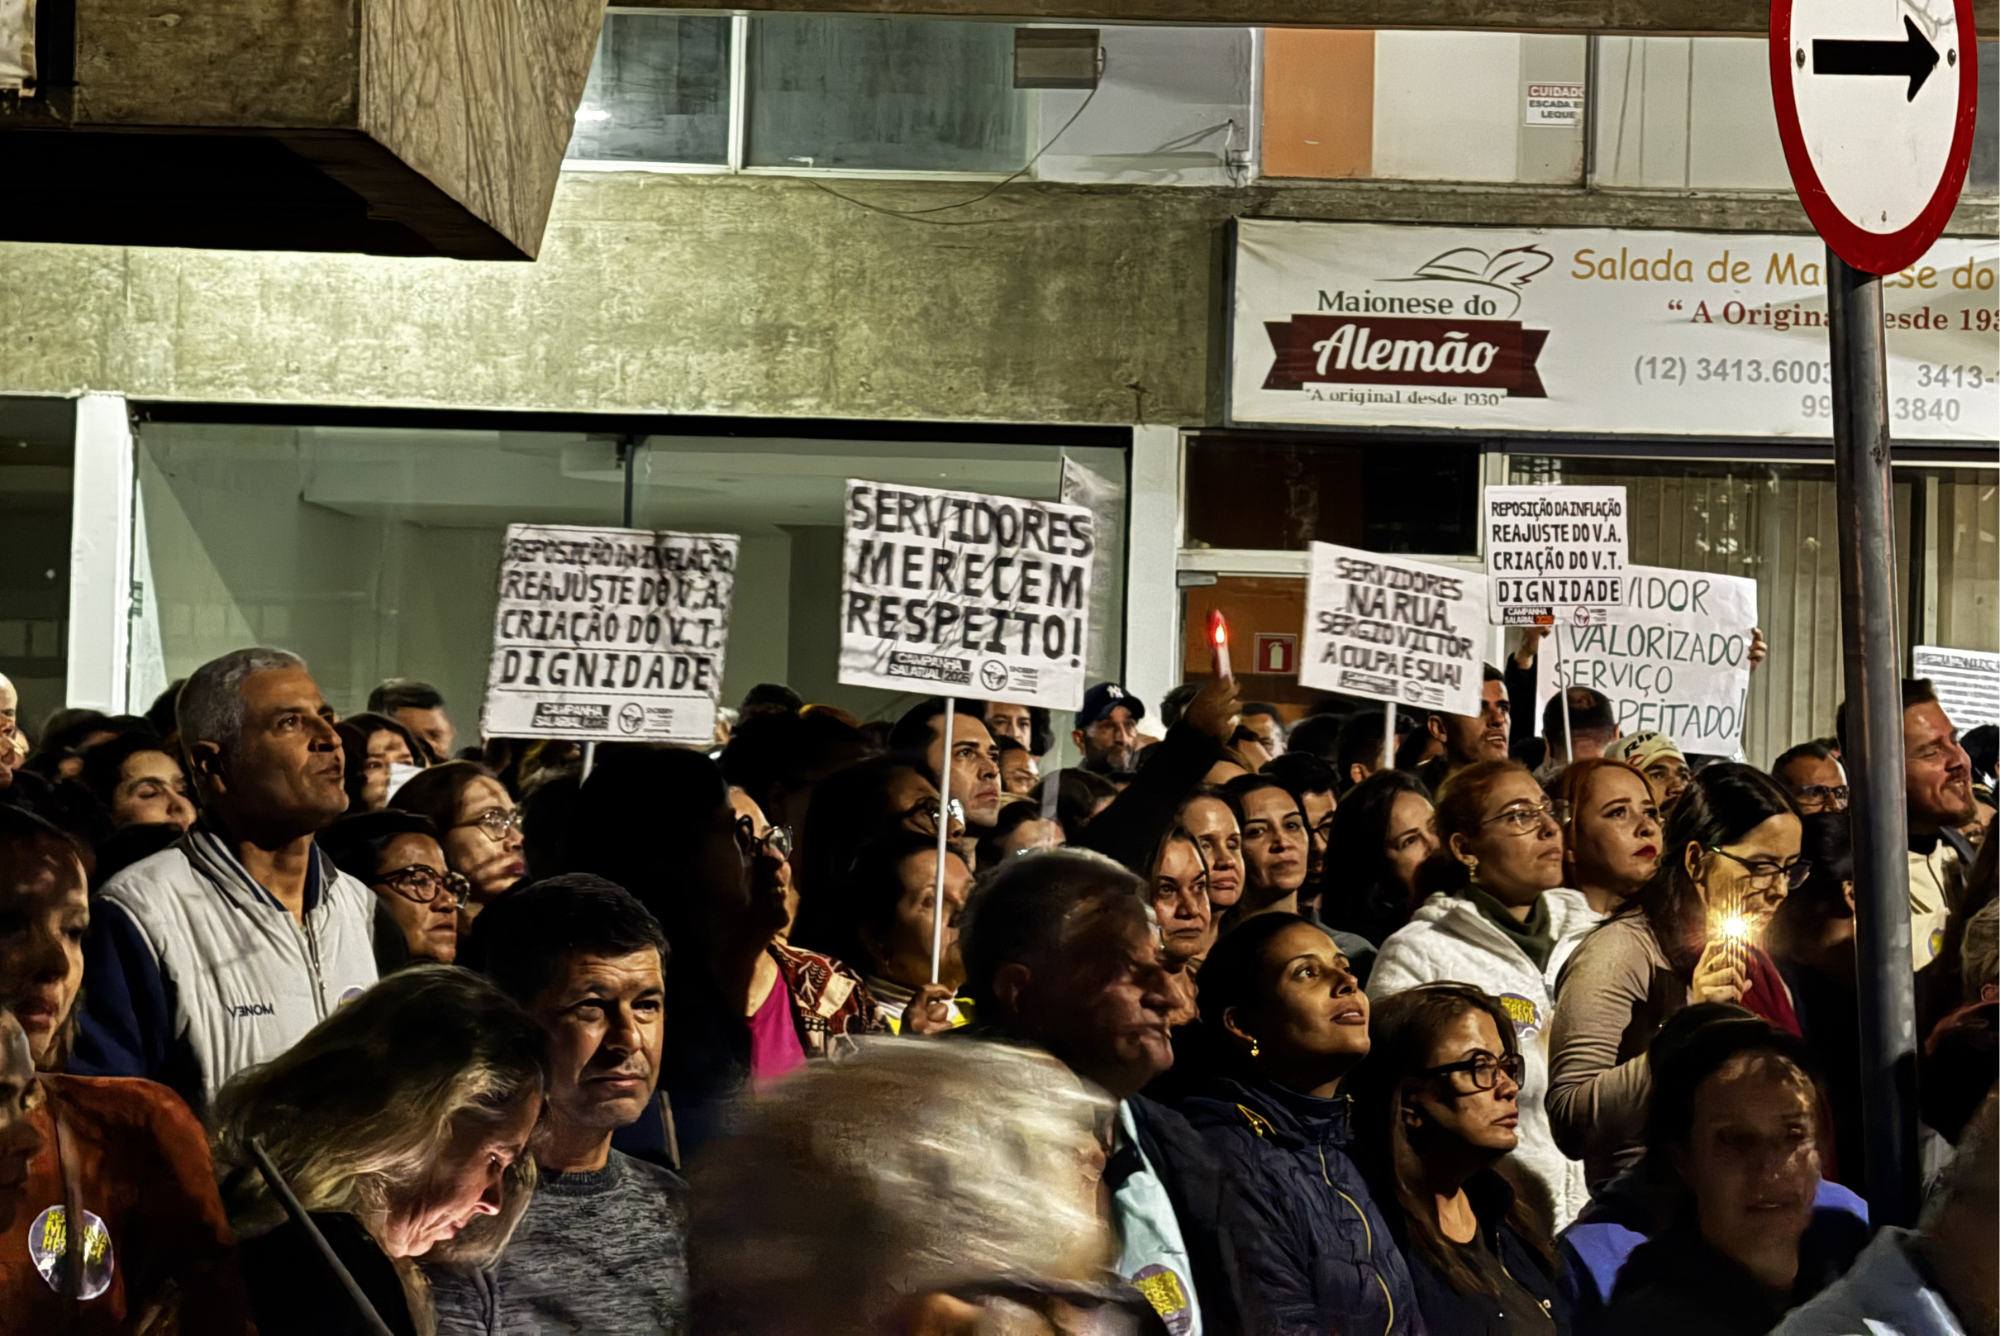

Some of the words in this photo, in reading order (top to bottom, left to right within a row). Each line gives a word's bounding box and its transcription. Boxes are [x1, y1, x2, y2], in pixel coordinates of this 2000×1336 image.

[1528, 100, 1571, 108] ESCADA
[1541, 110, 1576, 118] LEQUE
[1571, 247, 1694, 282] Salada
[1707, 250, 1752, 284] de
[1952, 256, 1995, 291] do
[1317, 289, 1454, 315] Maionese
[1464, 295, 1497, 316] do
[1723, 301, 1829, 331] Origin
[1885, 306, 1948, 331] esde
[1312, 323, 1500, 376] Alemão
[1634, 355, 1687, 386] (12)
[1917, 363, 2000, 389] 3413-
[1329, 389, 1401, 406] original
[1407, 391, 1457, 406] desde
[851, 486, 1094, 558] SERVIDORES
[1491, 497, 1553, 521] REPOSIÇÃO
[1492, 524, 1569, 542] REAJUSTE
[1572, 524, 1590, 542] DO
[1593, 524, 1622, 543] V.A.
[857, 539, 1085, 609] MERECEM
[1493, 546, 1564, 576] CRIAÇÃO
[1569, 551, 1588, 570] DO
[1592, 551, 1623, 571] V.T.
[502, 570, 635, 605] REAJUSTE
[638, 577, 670, 607] DO
[1334, 556, 1464, 600] SERVIDORES
[1498, 580, 1620, 603] DIGNIDADE
[1347, 583, 1387, 620] NA
[1507, 608, 1548, 616] CAMPANHA
[501, 604, 619, 647] CRIAÇÃO
[626, 615, 661, 645] DO
[669, 611, 721, 649] V.T.
[847, 591, 1082, 668] RESPEITO!
[1504, 616, 1535, 624] SALARIAL
[894, 652, 963, 671] CAMPANHA
[1318, 641, 1338, 665] A
[500, 649, 712, 690] DIGNIDADE
